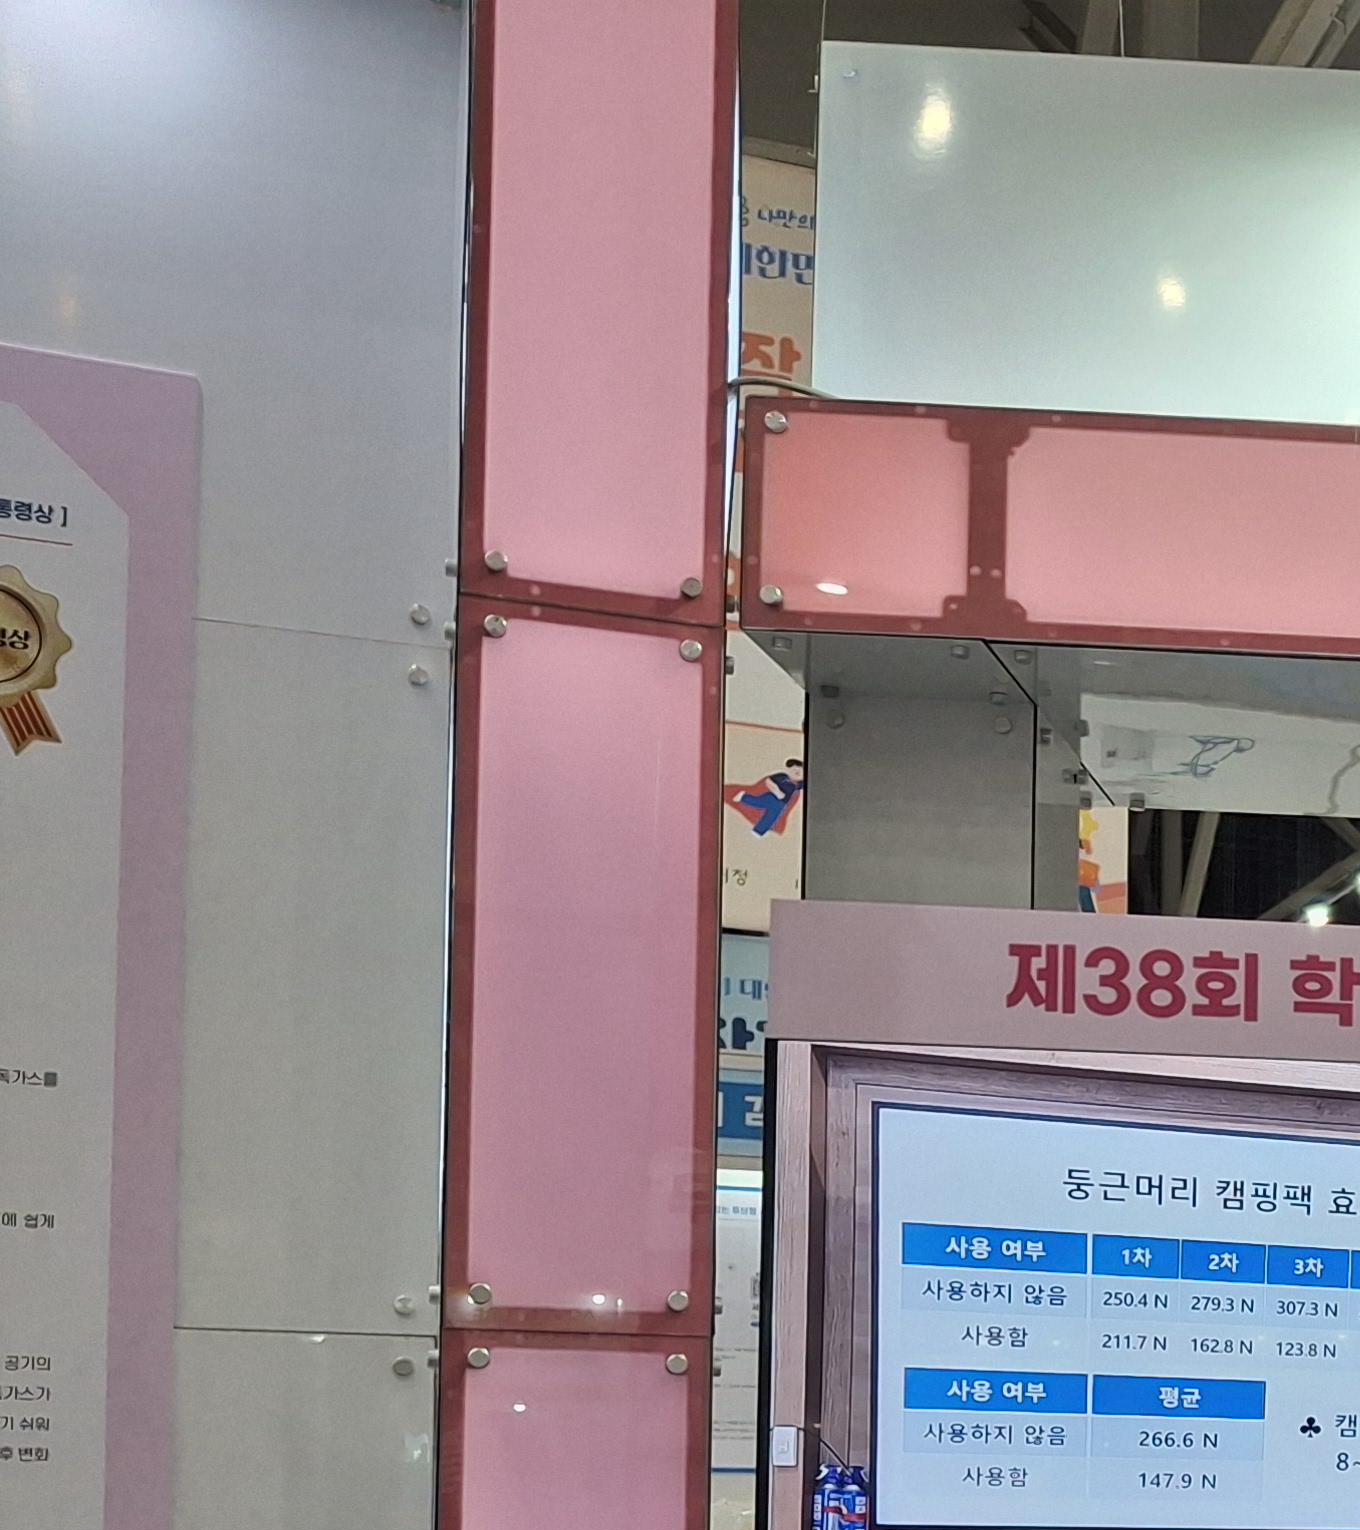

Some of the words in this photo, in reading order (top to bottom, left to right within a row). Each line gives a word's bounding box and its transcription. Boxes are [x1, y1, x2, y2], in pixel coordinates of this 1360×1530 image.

[1006, 943, 1259, 1022] 제38회
[1062, 1168, 1198, 1208] 둥근머리
[1215, 1179, 1313, 1217] 캠핑팩
[945, 1236, 992, 1260] 사용
[1001, 1240, 1047, 1263] 여부
[1121, 1248, 1152, 1269] 1차
[1208, 1252, 1240, 1274] 2차
[1293, 1257, 1324, 1279] 3차
[922, 1279, 1013, 1304] 사용하지
[1023, 1283, 1068, 1307] 않음
[1102, 1291, 1148, 1309] 250.4
[1154, 1294, 1168, 1309] N
[1190, 1295, 1235, 1313] 279.3
[1240, 1299, 1255, 1314] N
[1276, 1300, 1319, 1317] 307.3
[1324, 1303, 1338, 1318] N
[961, 1324, 1029, 1348] 사용함
[1101, 1334, 1147, 1350] 211.7
[1153, 1336, 1167, 1351] N
[1190, 1338, 1234, 1354] 162.8
[1239, 1340, 1253, 1356] N
[1275, 1342, 1318, 1358] 123.8
[1323, 1343, 1337, 1359] N
[5, 1355, 51, 1371] 공기의
[946, 1379, 993, 1403] 사용
[1002, 1382, 1047, 1404] 여부
[1158, 1386, 1201, 1409] 평균
[923, 1422, 1013, 1445] 사용하지
[1023, 1424, 1067, 1447] 않음
[1138, 1431, 1194, 1448] 266.6
[1203, 1433, 1218, 1449] N
[961, 1466, 1029, 1488] 사용함
[1138, 1472, 1192, 1489] 147.9
[1202, 1474, 1217, 1490] N
